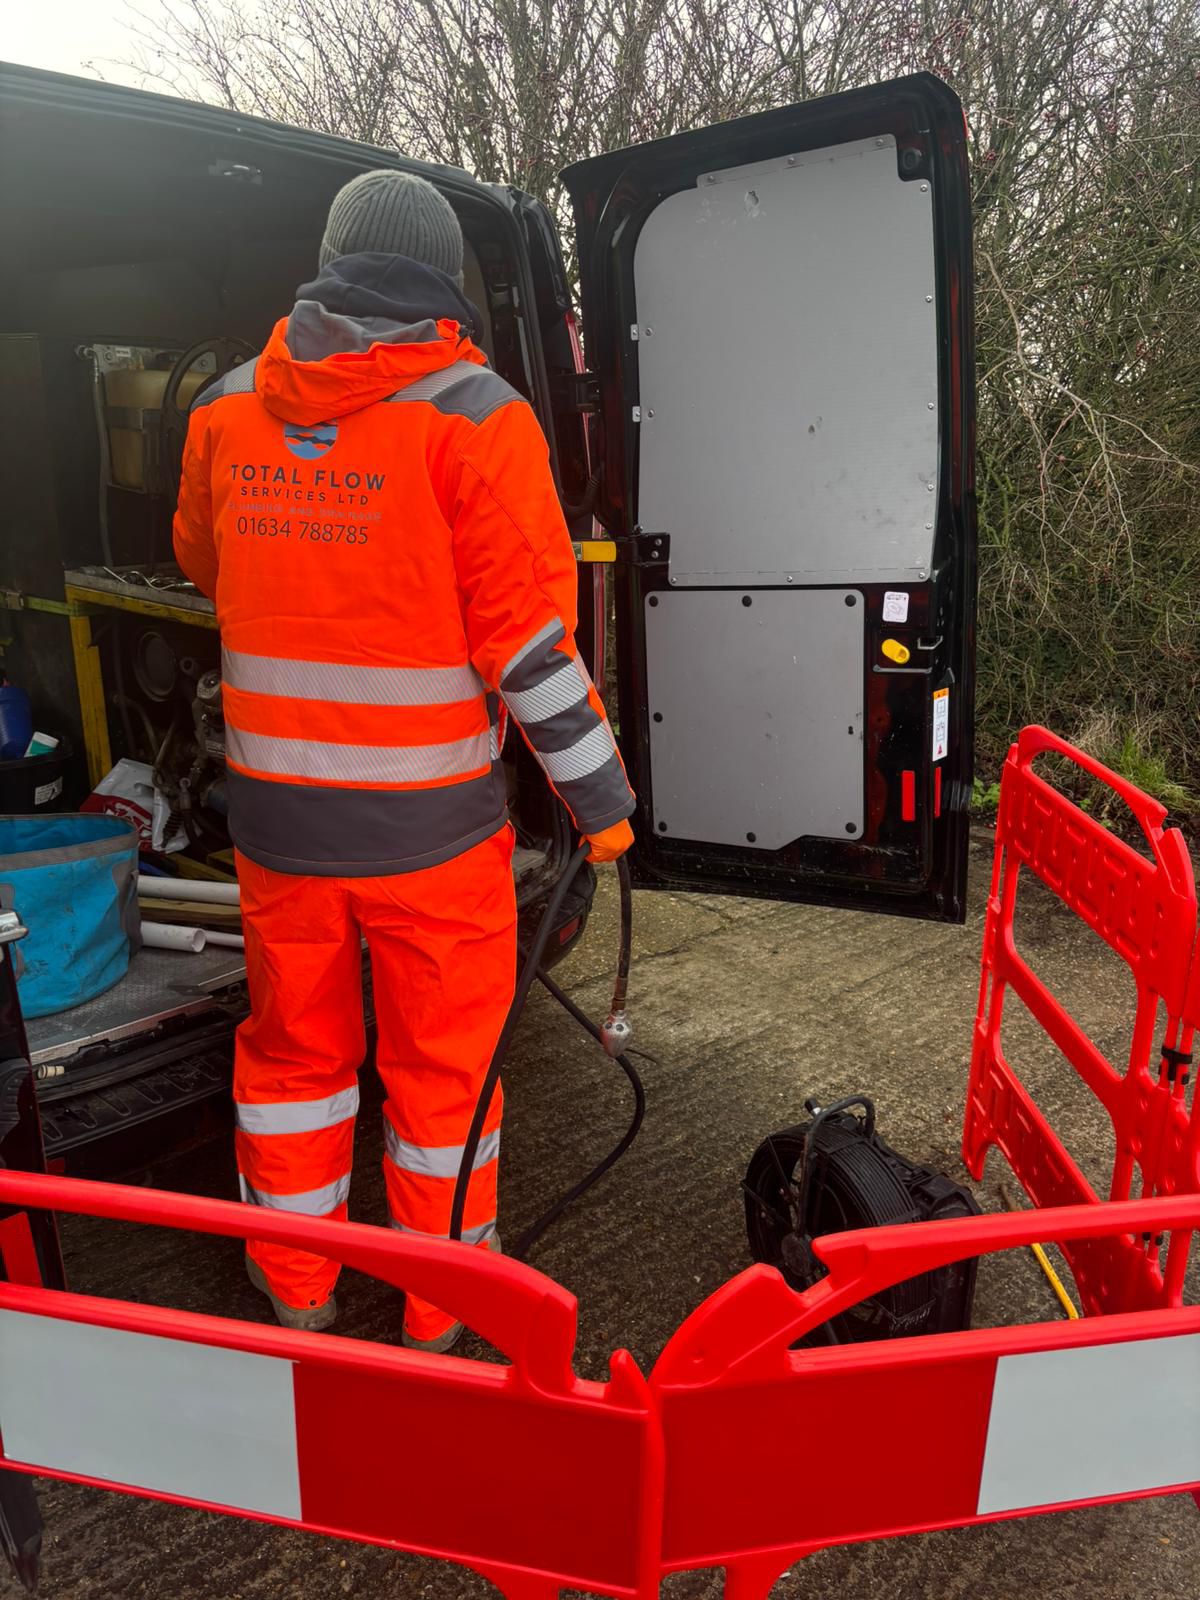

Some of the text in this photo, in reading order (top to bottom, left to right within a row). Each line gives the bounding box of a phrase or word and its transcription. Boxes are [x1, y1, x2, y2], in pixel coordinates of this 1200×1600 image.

[231, 464, 386, 491] TOTAL FLOW
[240, 486, 369, 505] SERVICES LTD
[237, 516, 368, 545] 01634 788785
